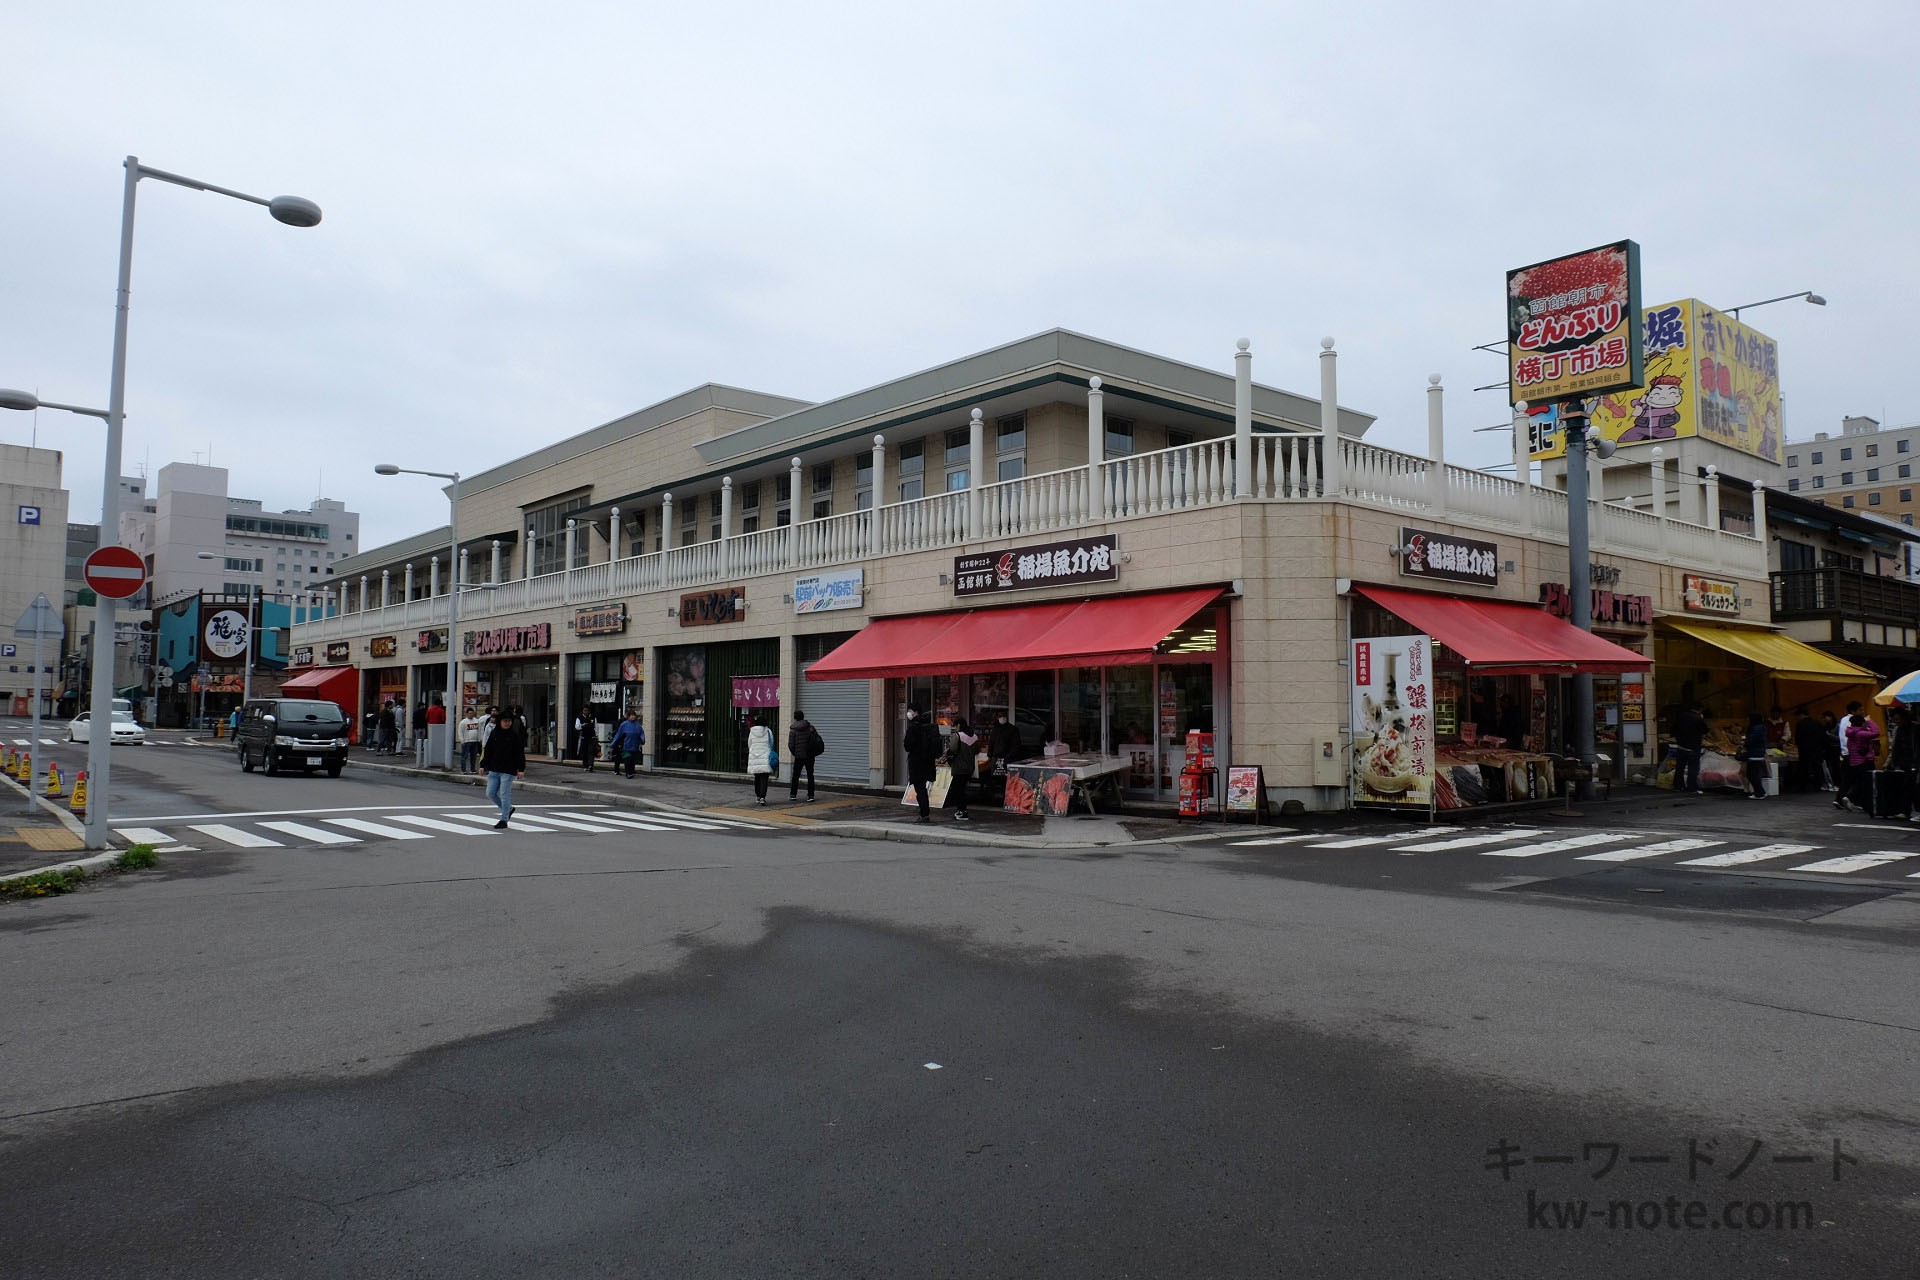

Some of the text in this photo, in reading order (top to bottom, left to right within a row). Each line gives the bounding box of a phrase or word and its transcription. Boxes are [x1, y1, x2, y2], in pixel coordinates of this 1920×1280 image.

[1529, 283, 1608, 316] 函館朝市
[1517, 301, 1622, 351] どんぶり
[1514, 336, 1627, 387] 横丁市場
[21, 507, 38, 523] P
[957, 573, 993, 590] 函館朝市
[1546, 583, 1653, 625] どんり横丁市場
[3, 645, 15, 656] P
[474, 623, 551, 655] どんぶり横丁市場
